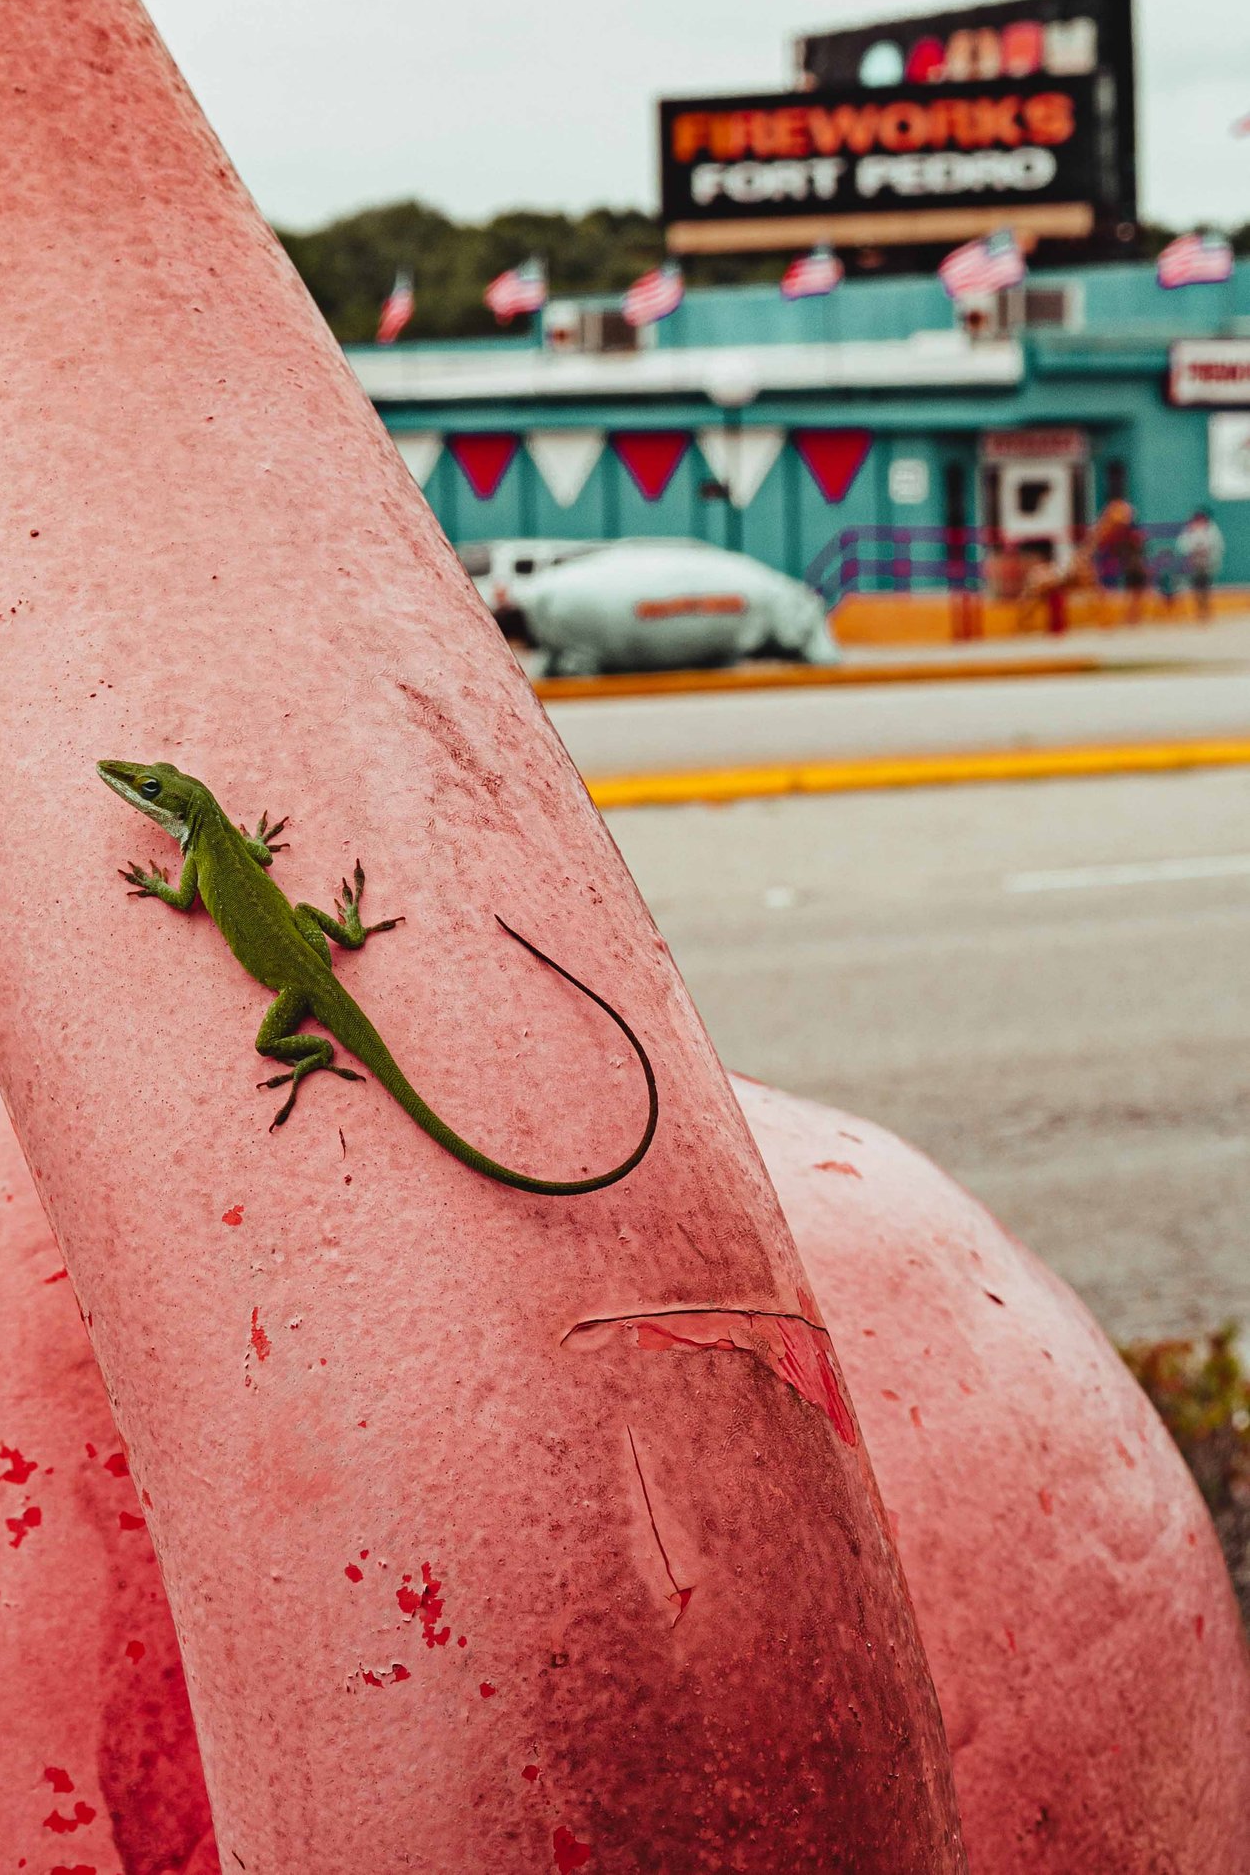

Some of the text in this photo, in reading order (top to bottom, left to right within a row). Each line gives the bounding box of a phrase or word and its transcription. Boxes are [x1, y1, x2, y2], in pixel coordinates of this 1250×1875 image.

[672, 92, 1075, 163] FIREWORKS
[691, 146, 1056, 205] FORT PEDRO
